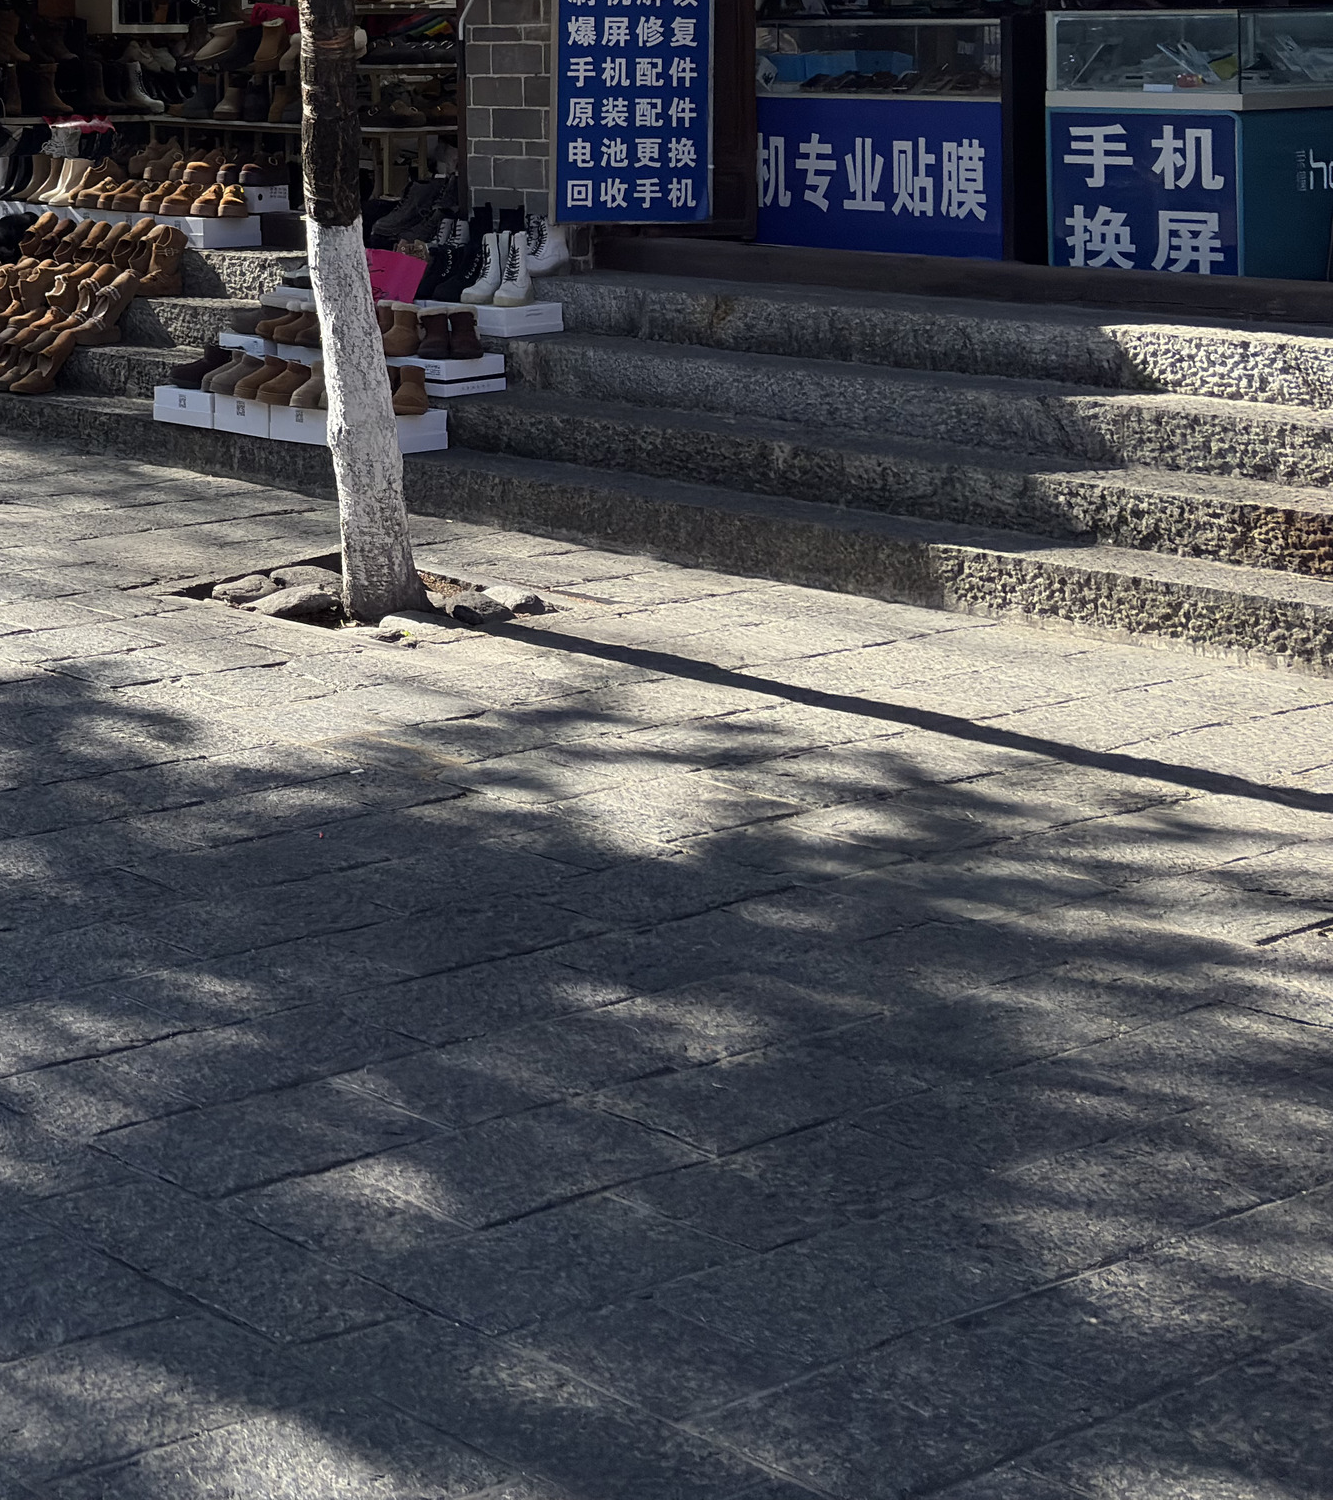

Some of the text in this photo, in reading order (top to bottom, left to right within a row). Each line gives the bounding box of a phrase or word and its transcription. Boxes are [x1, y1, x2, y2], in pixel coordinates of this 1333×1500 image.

[567, 16, 698, 47] 爆屏修复
[567, 56, 698, 88] 手机配件
[566, 97, 697, 128] 原装配件
[567, 137, 697, 169] 电池更换
[1064, 124, 1224, 191] 手机
[566, 178, 696, 208] 回收手机
[757, 132, 987, 222] 机专业贴膜
[1065, 205, 1225, 275] 换屏
